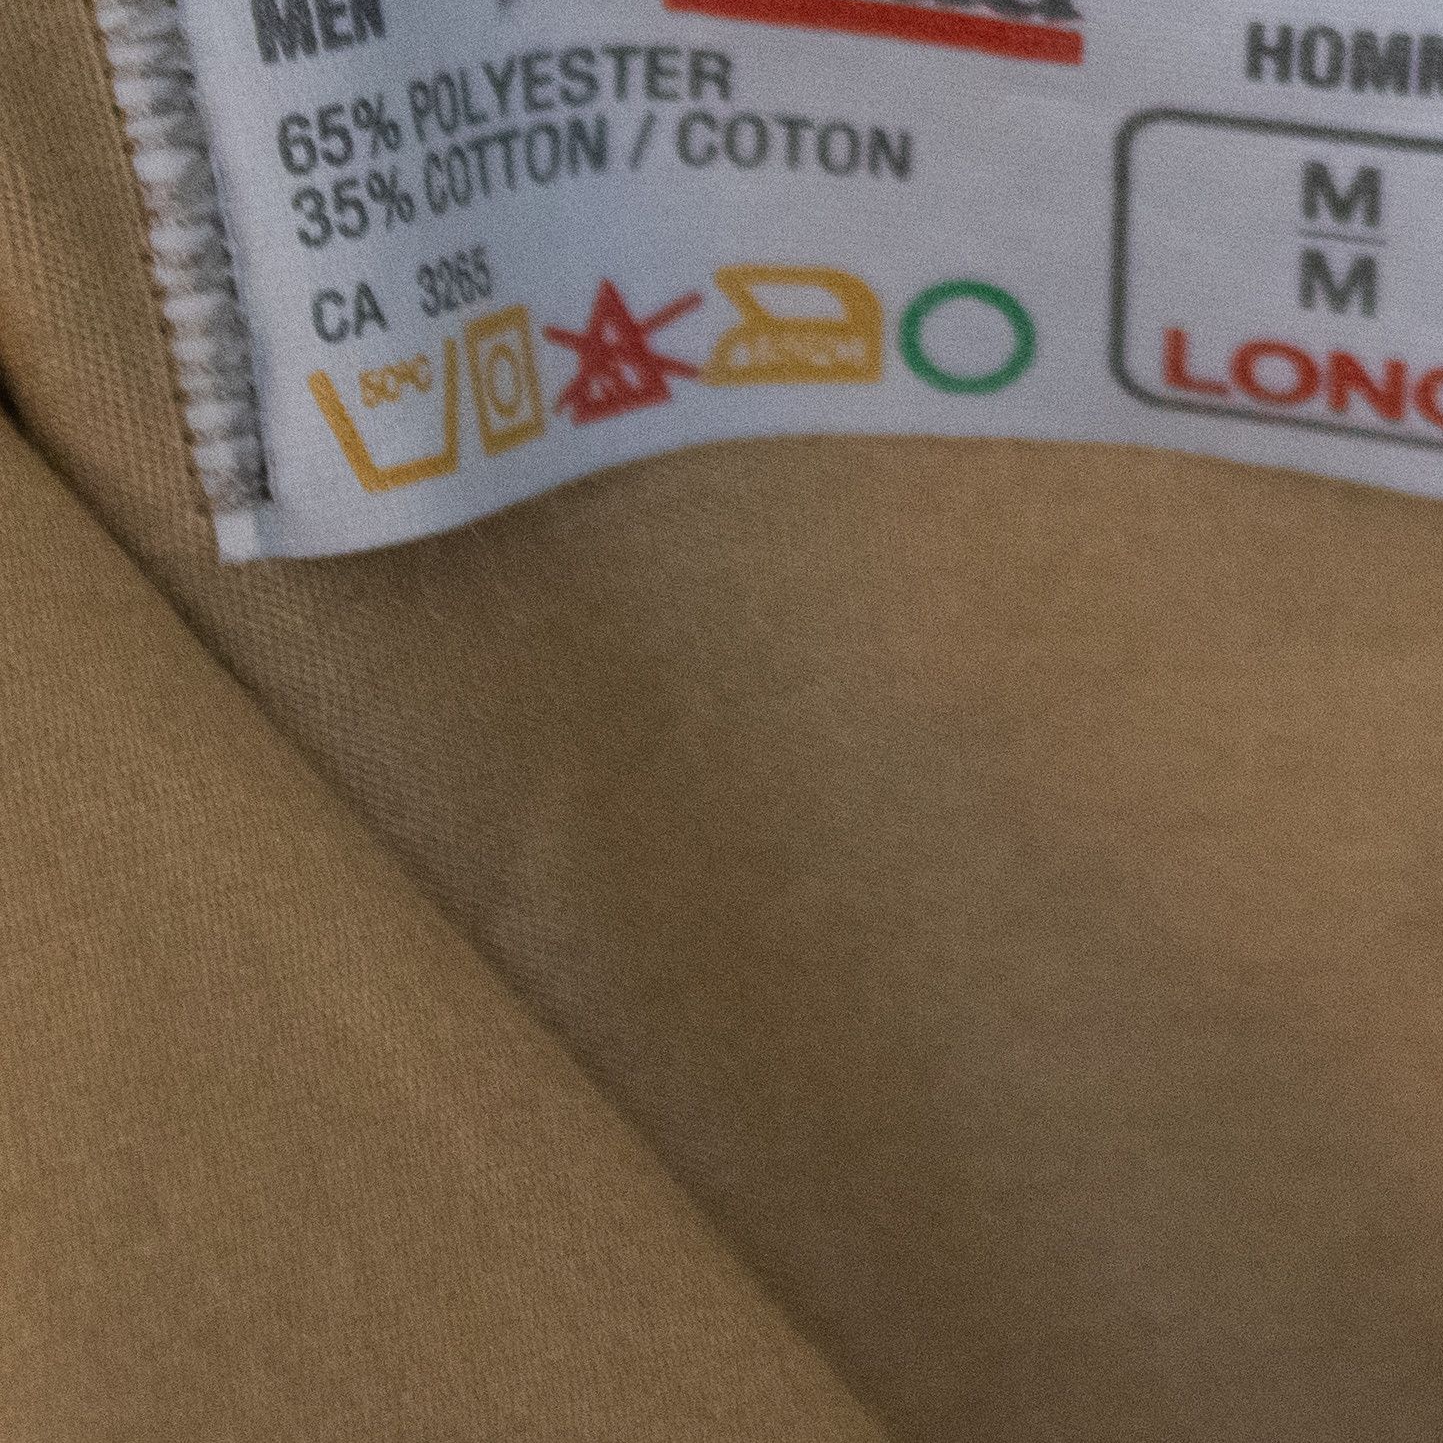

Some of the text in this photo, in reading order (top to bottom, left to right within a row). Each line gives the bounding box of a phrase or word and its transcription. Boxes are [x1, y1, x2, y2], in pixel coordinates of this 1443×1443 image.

[276, 45, 735, 177] 65% POLYESTER
[290, 110, 915, 250] 35% COTTON / COTON
[1301, 160, 1383, 228] M
[311, 278, 390, 345] CA
[1301, 249, 1379, 318] M
